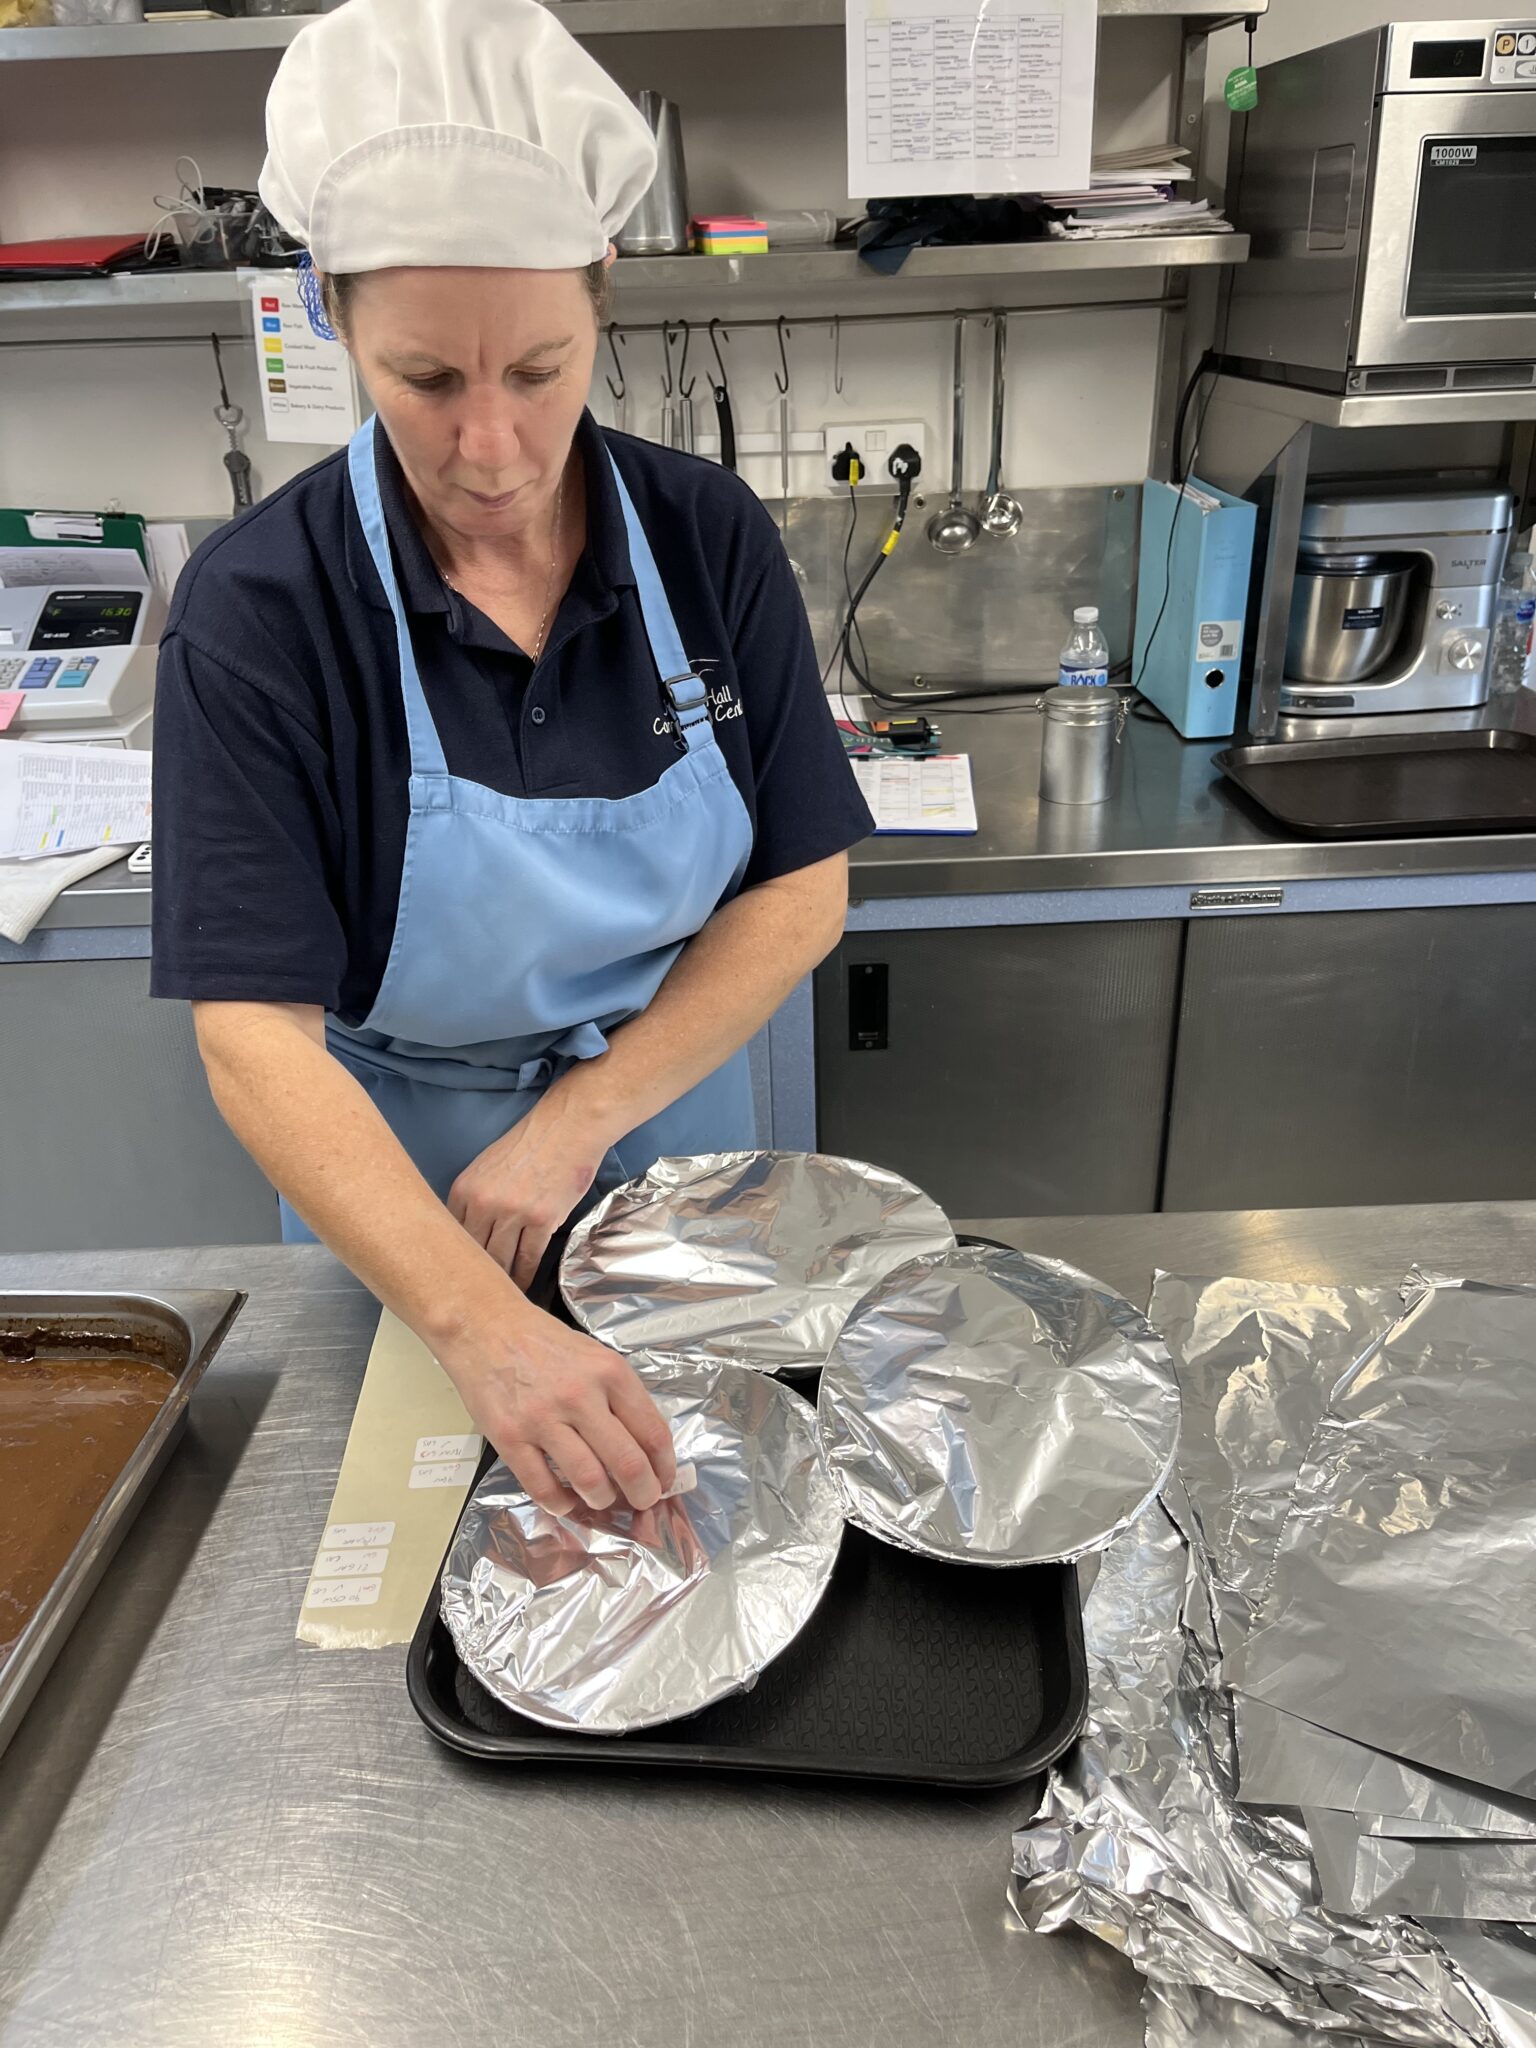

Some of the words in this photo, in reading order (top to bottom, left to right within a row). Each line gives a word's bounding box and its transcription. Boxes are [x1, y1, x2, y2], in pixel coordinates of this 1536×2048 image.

[1502, 38, 1511, 51] P
[1435, 147, 1473, 158] 1000W
[1451, 559, 1487, 569] SALTER
[706, 684, 733, 707] Hall
